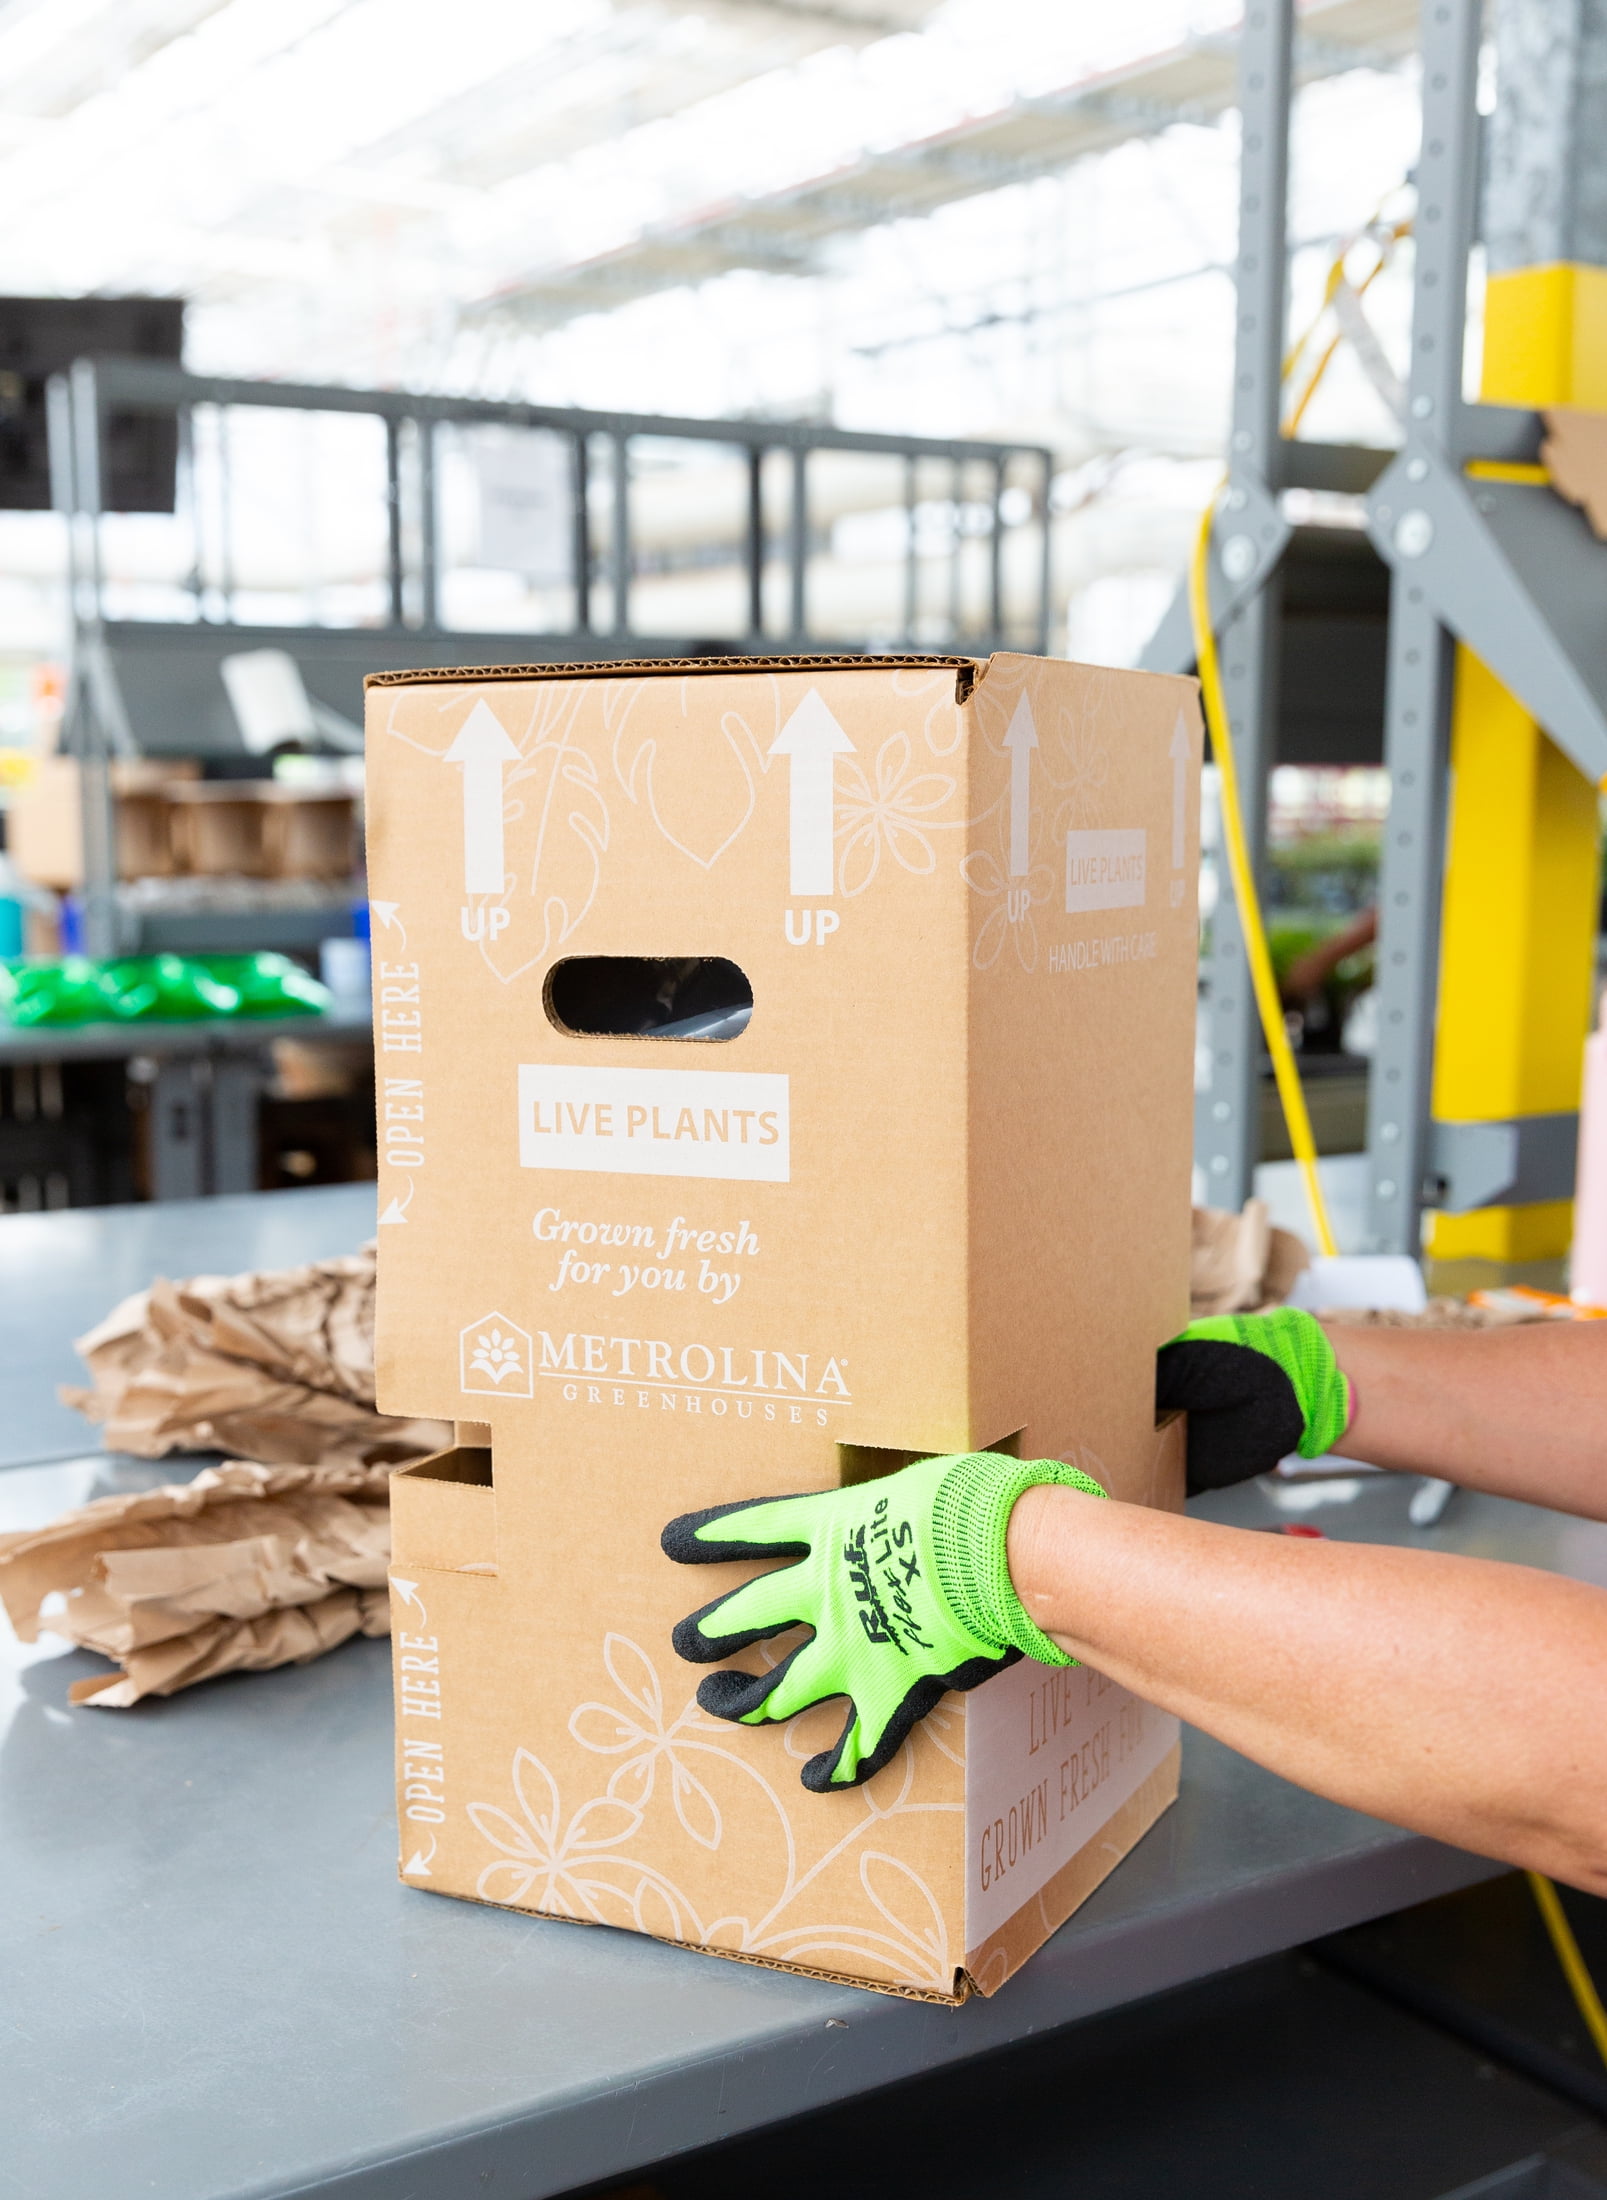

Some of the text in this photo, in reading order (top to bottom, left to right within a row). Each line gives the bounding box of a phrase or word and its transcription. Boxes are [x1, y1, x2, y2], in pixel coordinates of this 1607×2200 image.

[1071, 855, 1144, 886] LIVE PLANTS
[461, 906, 511, 942] UP
[784, 909, 841, 946] UP
[1007, 889, 1031, 924] UP
[1049, 938, 1099, 974] HANDLE
[1101, 935, 1129, 965] WITH
[380, 961, 425, 1168] OPEN HERE
[532, 1101, 780, 1146] LIVE PLANTS
[532, 1207, 761, 1260] Grown fresh
[548, 1250, 742, 1305] for you by
[563, 1385, 829, 1427] GREENHOUSES
[870, 1497, 893, 1565] Lite
[892, 1521, 922, 1587] XS
[399, 1631, 446, 1825] OPEN HERE
[1028, 1664, 1072, 1757] LIVE
[980, 1778, 1049, 1893] GROWN
[1059, 1719, 1112, 1823] FRESH
